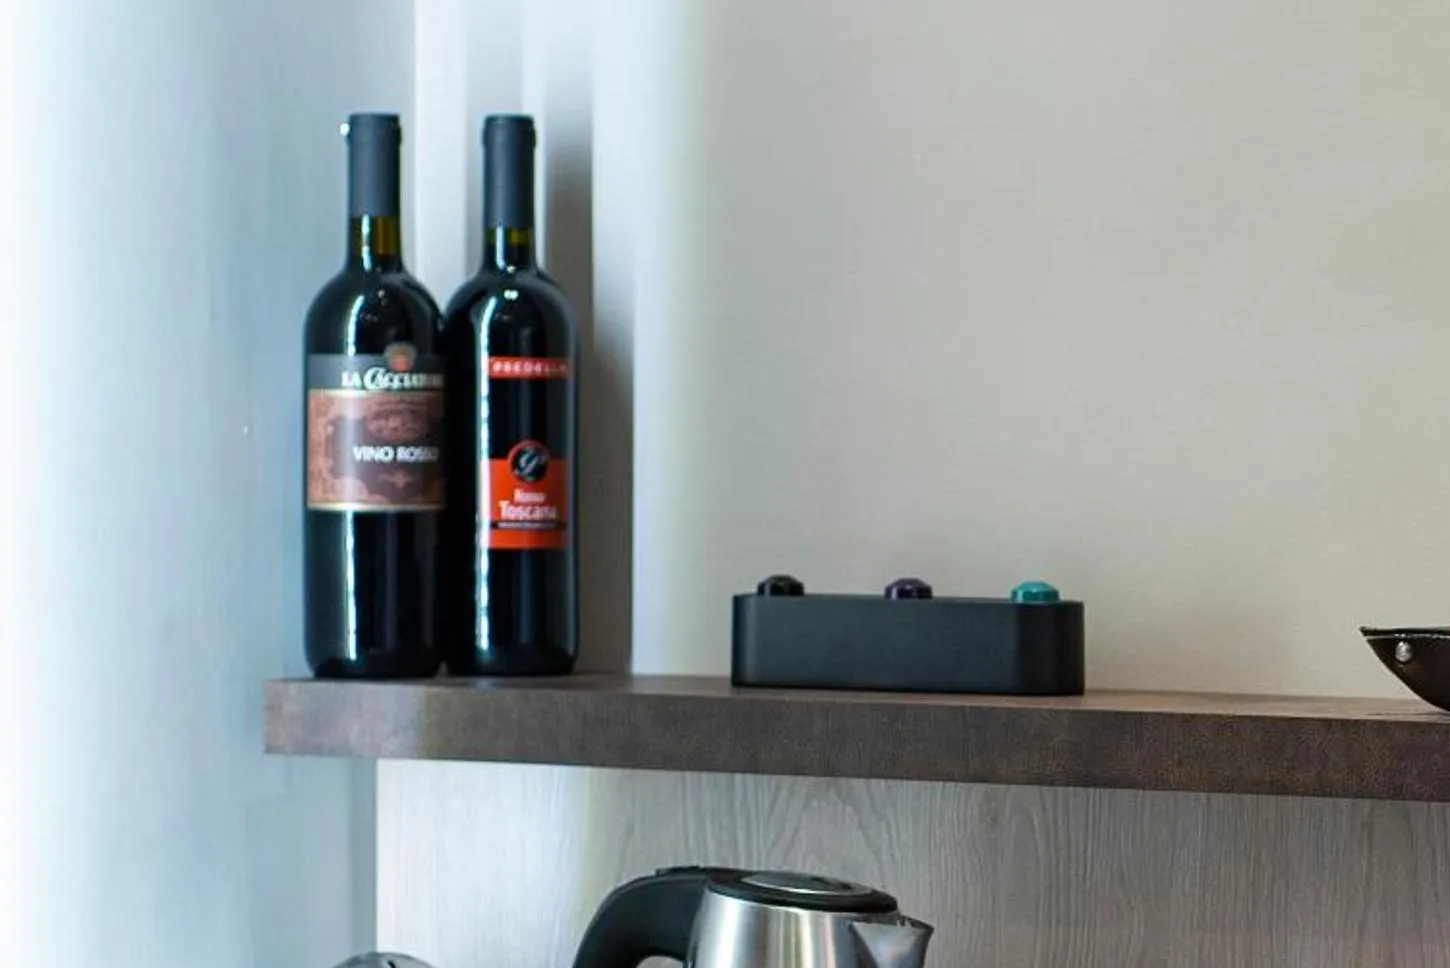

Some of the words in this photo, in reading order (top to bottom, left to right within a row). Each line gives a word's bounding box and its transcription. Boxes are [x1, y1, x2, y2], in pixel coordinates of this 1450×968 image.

[341, 371, 361, 389] LA
[352, 446, 395, 462] VINO
[396, 446, 439, 462] ROSSO
